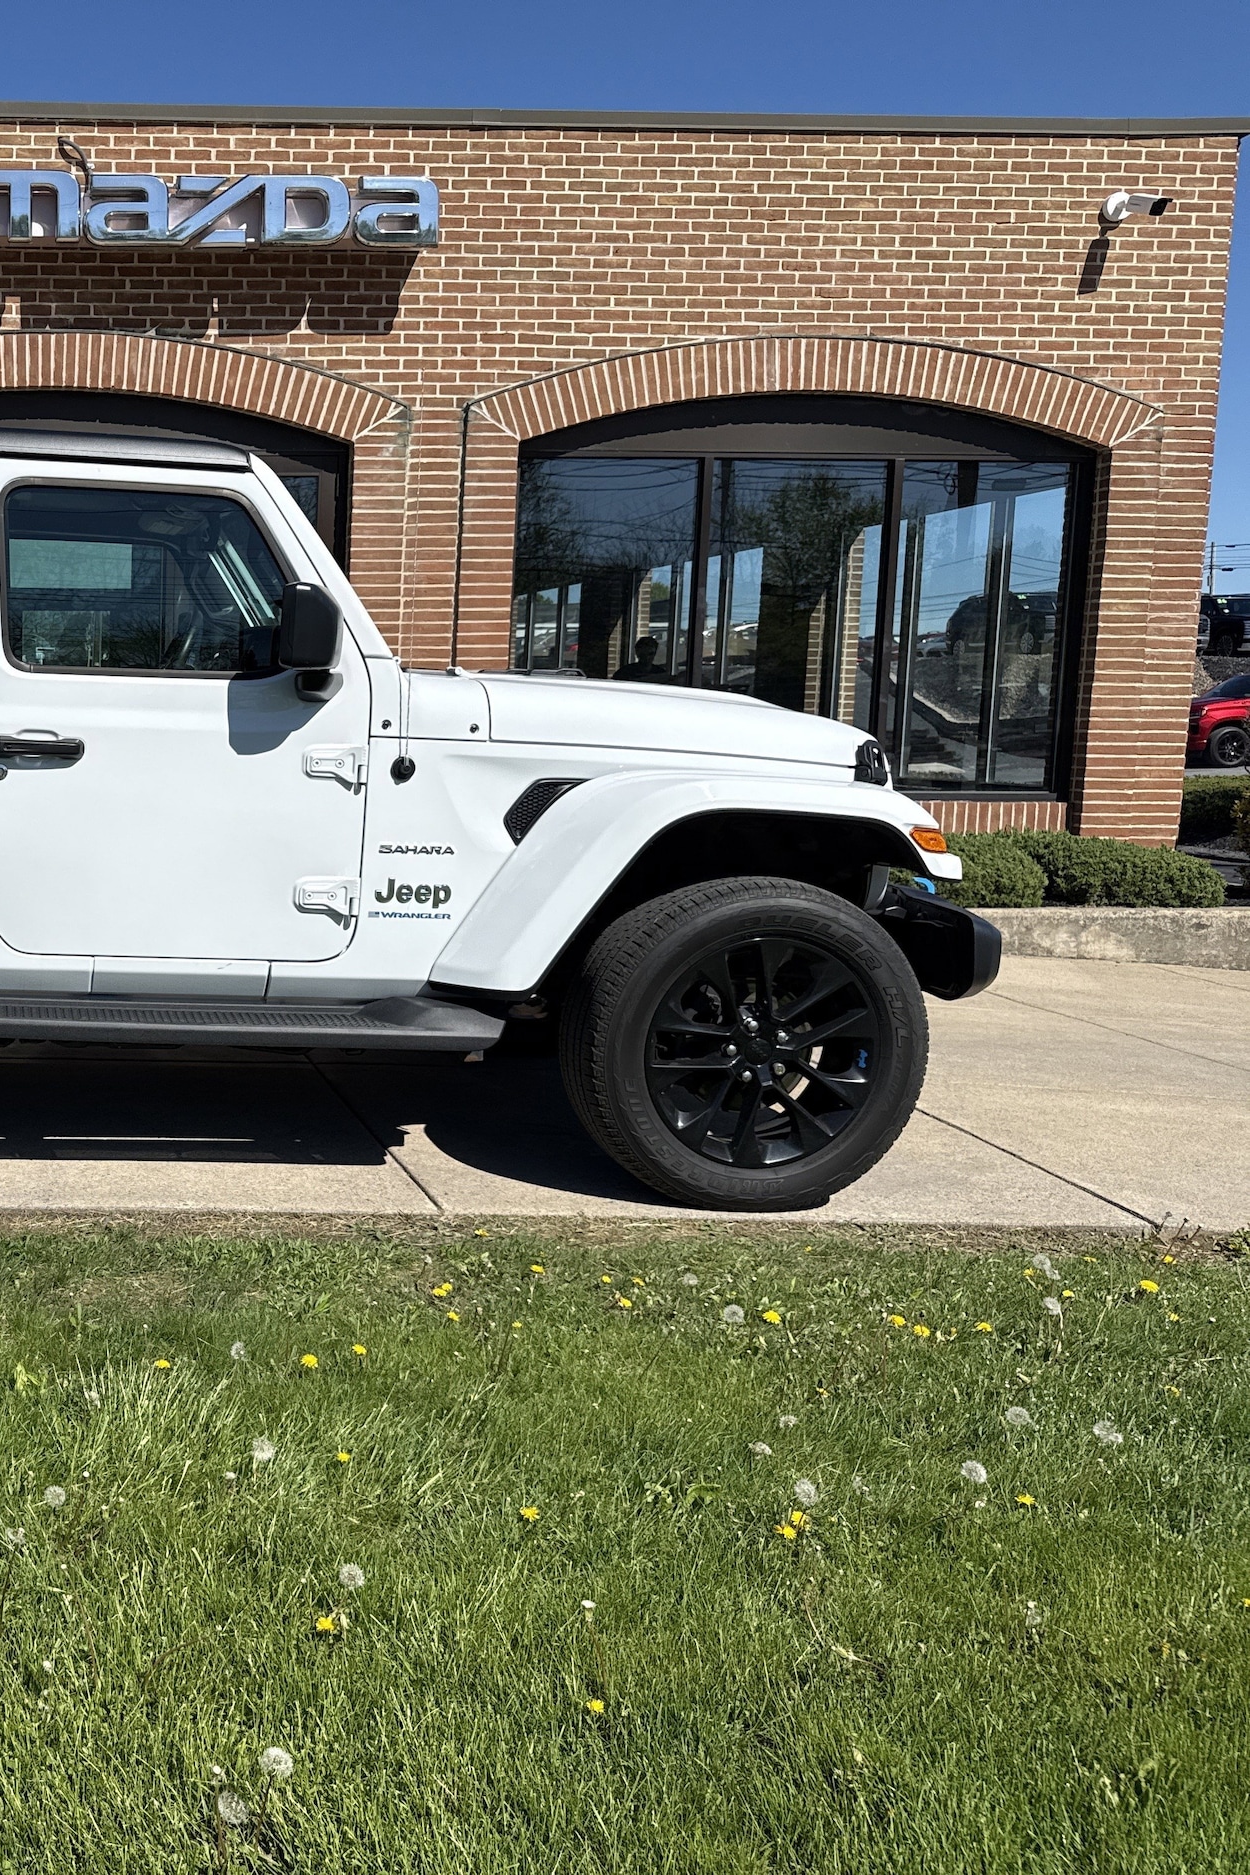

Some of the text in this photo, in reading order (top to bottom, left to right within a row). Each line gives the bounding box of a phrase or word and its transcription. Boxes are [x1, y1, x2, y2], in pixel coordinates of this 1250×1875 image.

[378, 844, 455, 856] SAHARA
[374, 877, 452, 909] Jeep
[380, 911, 452, 920] WRANGLER
[738, 914, 882, 971] DUELER
